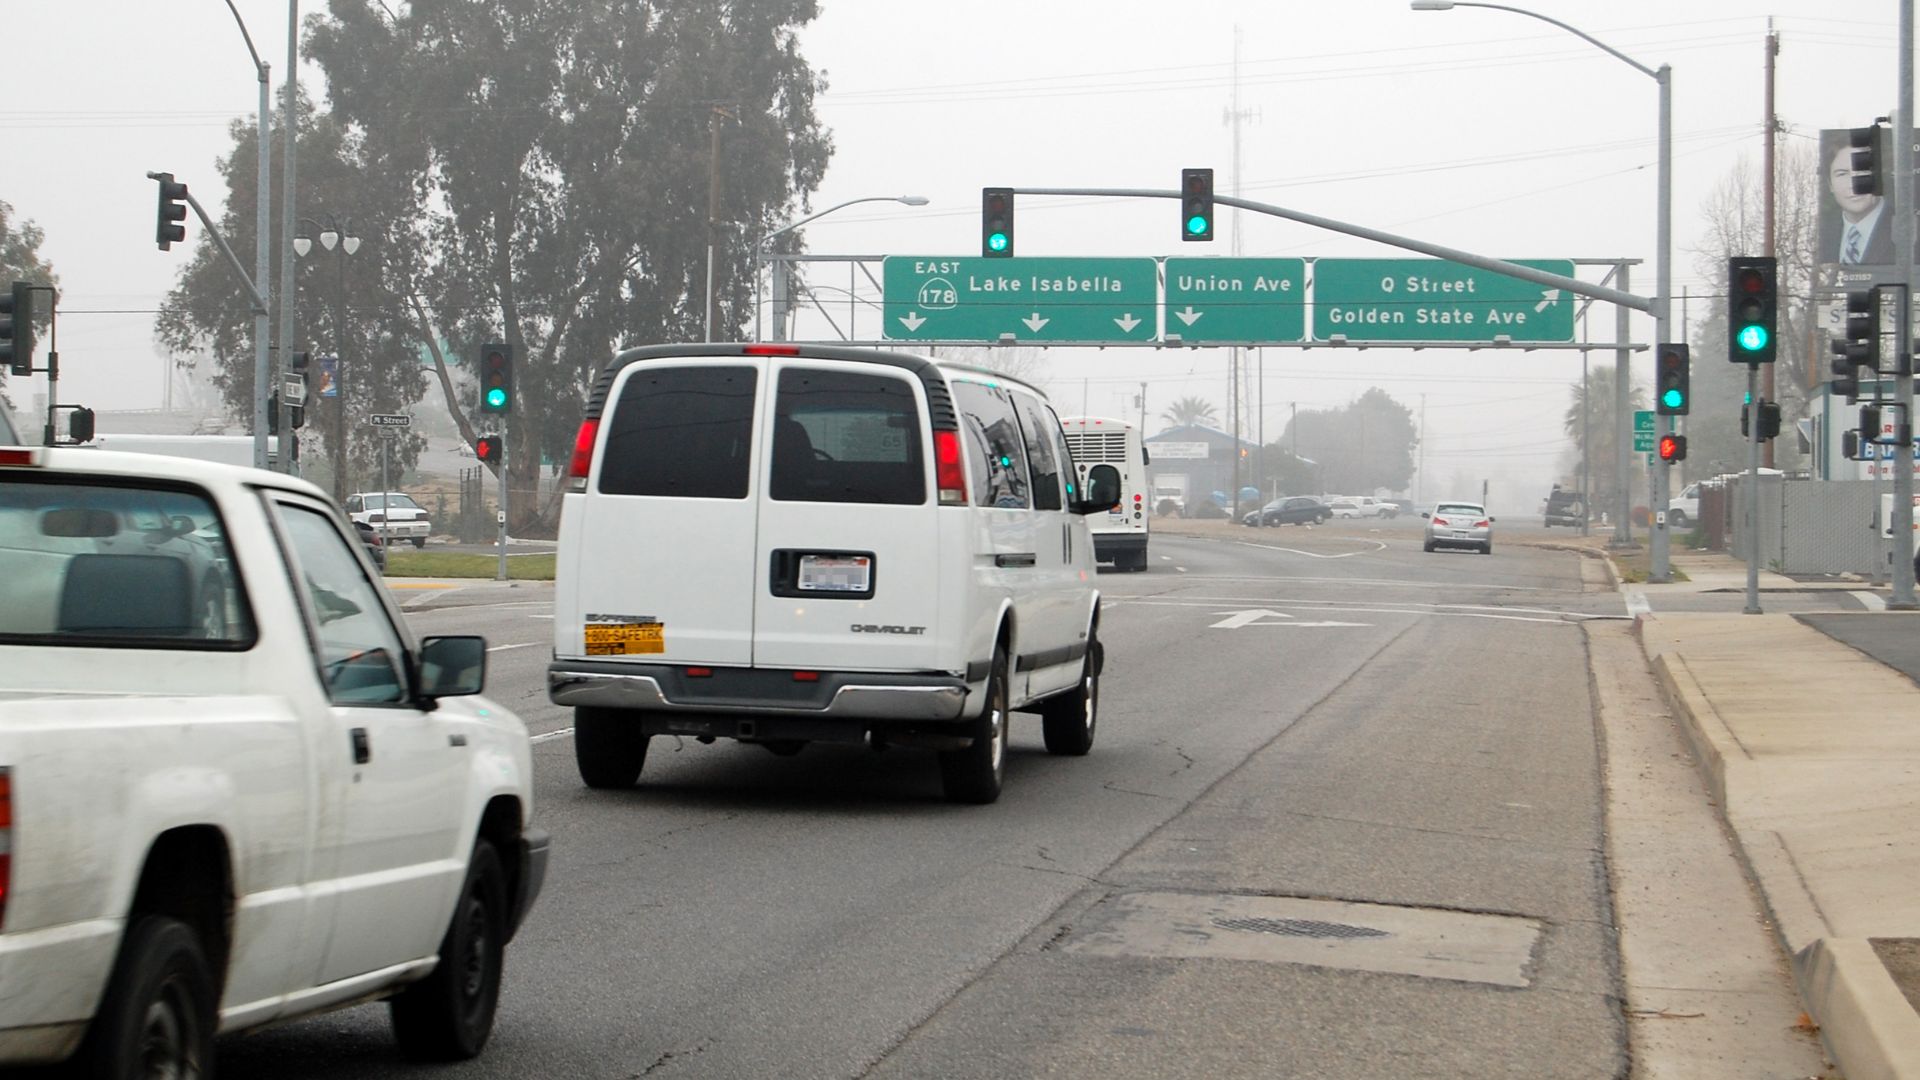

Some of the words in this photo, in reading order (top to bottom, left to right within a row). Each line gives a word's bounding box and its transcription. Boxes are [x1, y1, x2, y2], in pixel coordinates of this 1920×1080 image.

[915, 261, 960, 274] EAST
[969, 276, 1021, 292] Lake
[1032, 276, 1122, 292] Isabella
[1179, 276, 1242, 291] Union
[1254, 276, 1291, 292] Ave
[1381, 277, 1394, 292] Q
[1407, 276, 1475, 292] Street
[922, 289, 955, 304] 178
[1329, 308, 1404, 324] Golden
[1416, 308, 1473, 324] State
[1486, 308, 1527, 324] Ave
[383, 416, 408, 424] Street
[851, 624, 926, 634] CHEVROLET
